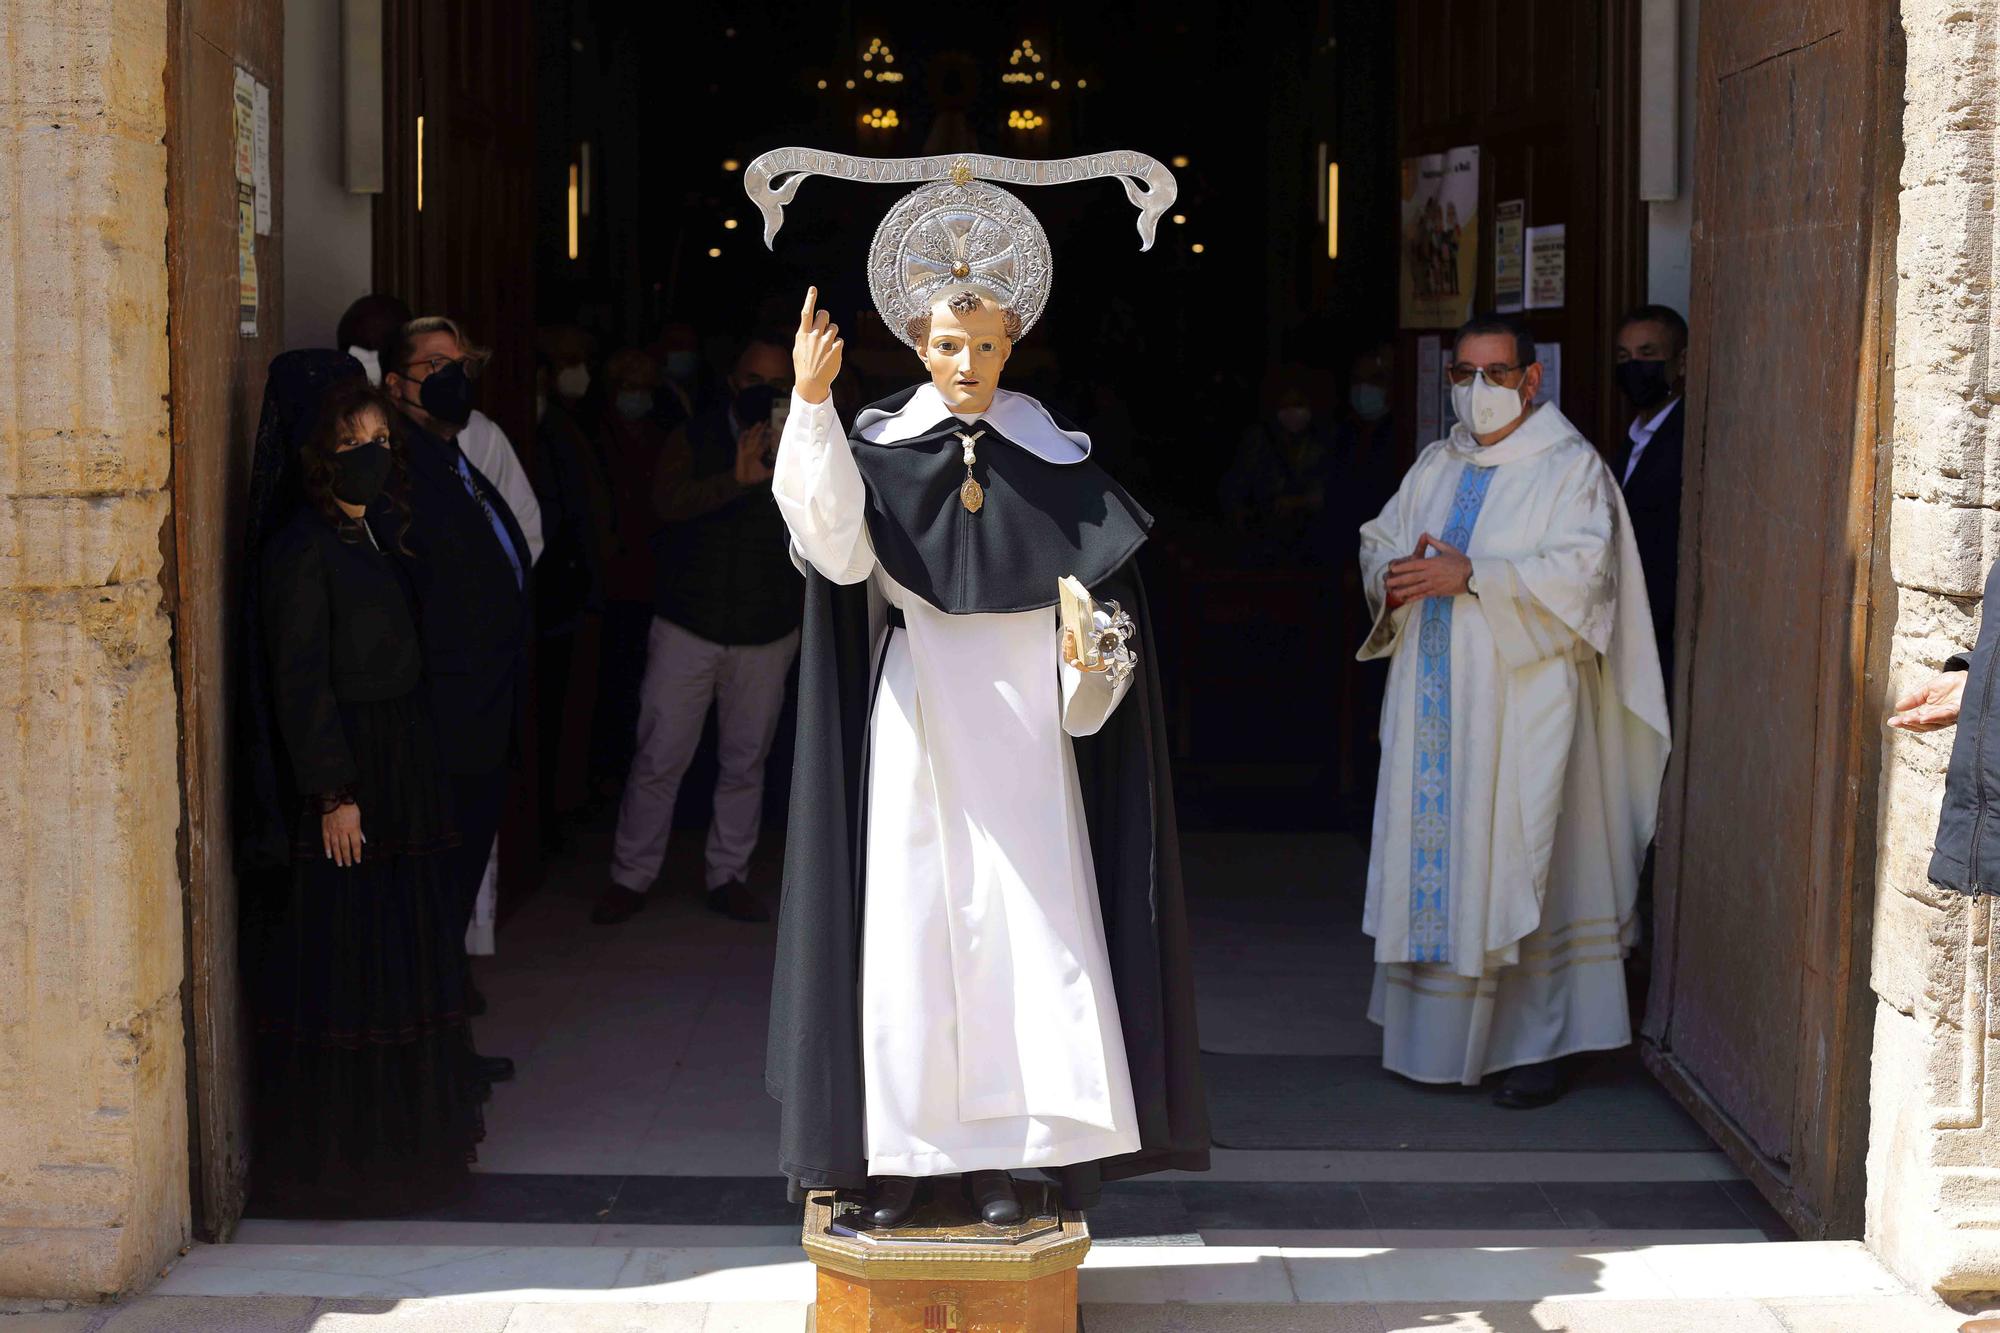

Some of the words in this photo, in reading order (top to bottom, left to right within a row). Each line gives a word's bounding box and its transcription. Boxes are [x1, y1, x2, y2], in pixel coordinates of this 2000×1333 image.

[753, 150, 838, 178] TIMETE
[1000, 160, 1038, 183] ILLI
[1043, 153, 1155, 182] HONOREM
